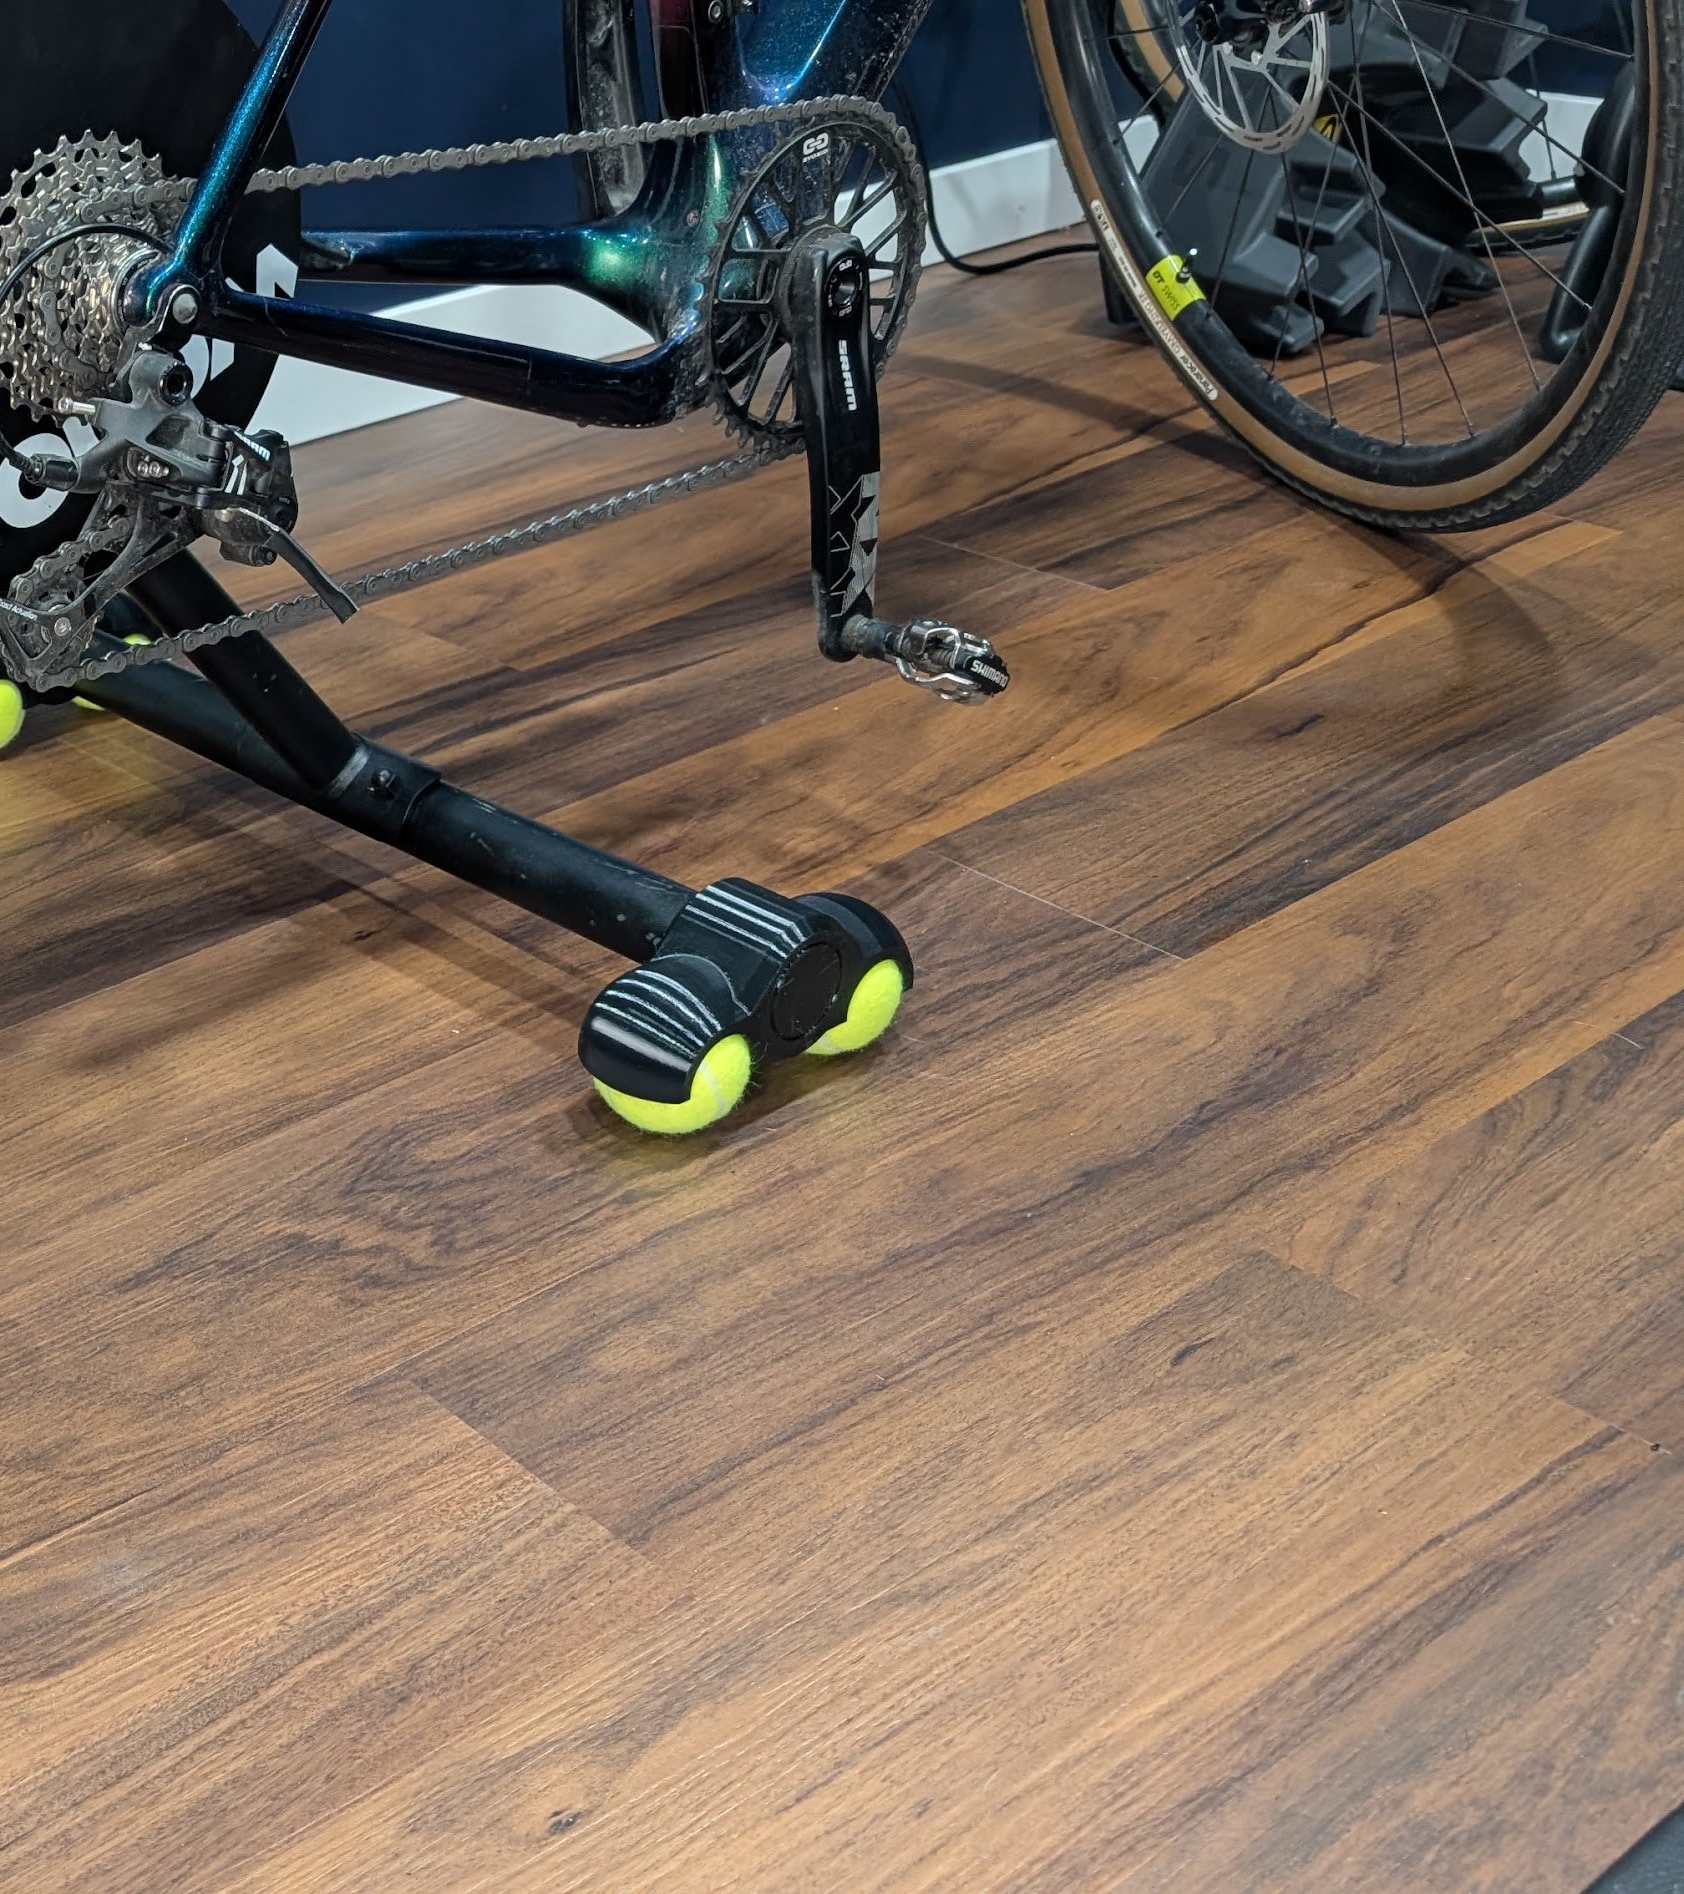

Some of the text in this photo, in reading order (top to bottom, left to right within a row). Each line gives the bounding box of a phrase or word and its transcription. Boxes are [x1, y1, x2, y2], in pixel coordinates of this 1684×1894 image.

[1153, 270, 1181, 311] DT SWISS
[836, 339, 858, 412] SRAM
[1179, 354, 1214, 395] Panaracer
[969, 658, 1009, 689] SHIMANO
